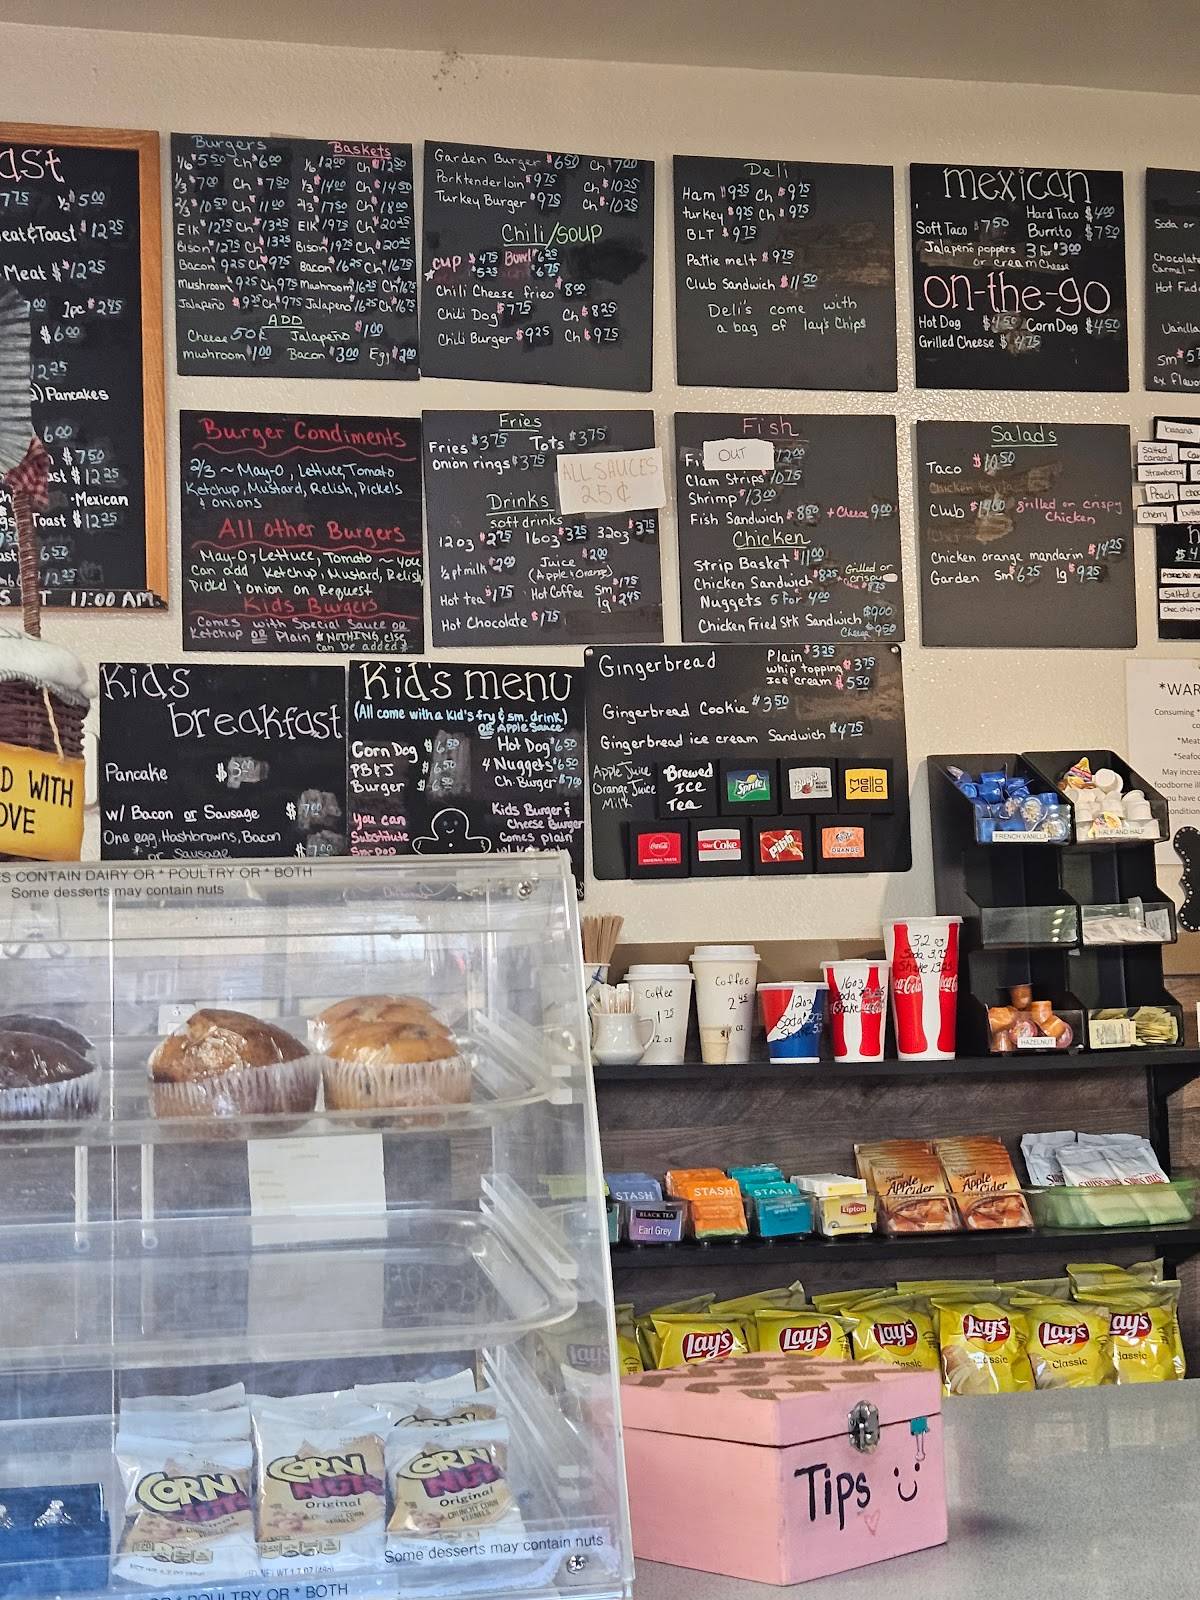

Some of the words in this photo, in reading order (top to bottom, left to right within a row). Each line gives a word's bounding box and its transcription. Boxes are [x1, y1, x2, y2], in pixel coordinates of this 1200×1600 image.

[192, 135, 267, 156] Burgers
[328, 141, 391, 157] Baskets
[435, 149, 487, 164] Garden
[494, 153, 541, 171] Burger
[744, 163, 788, 178] Deli
[435, 190, 480, 206] Turkey
[484, 193, 527, 214] Burger
[682, 187, 715, 202] Ham
[1027, 206, 1053, 219] Hard
[1056, 207, 1079, 219] Taco
[916, 220, 942, 235] Soft
[945, 224, 968, 235] Taco
[1028, 224, 1072, 239] Burrito
[1155, 220, 1178, 228] Soda
[687, 229, 714, 240] BLT
[177, 241, 210, 253] Bison
[296, 240, 328, 252] Bison
[4, 265, 47, 281] Meat
[924, 271, 1110, 316] on-the-go
[438, 308, 465, 320] Chili
[473, 308, 498, 328] Dog
[919, 316, 938, 328] Hot
[941, 317, 961, 329] Dog
[438, 332, 465, 346] Chili
[471, 333, 513, 348] Burger
[919, 335, 954, 348] Grilled
[957, 335, 994, 349] Cheese
[46, 386, 109, 401] Pancakes
[499, 413, 542, 428] Fries
[743, 417, 798, 437] Fish
[199, 418, 285, 449] Burger
[294, 421, 406, 447] Condiments
[991, 426, 1057, 444] Salads
[429, 442, 468, 455] Fries
[530, 436, 565, 450] Tots
[719, 447, 747, 462] OUT
[473, 456, 511, 475] rings
[561, 465, 593, 481] ALL
[600, 458, 659, 479] SAUCES
[926, 461, 962, 474] Taco
[686, 475, 719, 487] Clam
[726, 473, 764, 486] Strips
[689, 493, 737, 507] Shrimp
[1150, 487, 1175, 499] Peach
[487, 492, 549, 511] Drinks
[690, 513, 718, 526] Fish
[726, 509, 783, 525] Sandwich
[930, 505, 964, 517] Club
[733, 528, 811, 547] Chicken
[931, 552, 976, 563] Chicken
[982, 553, 1023, 566] orange
[1030, 548, 1083, 561] mandarin
[694, 576, 744, 591] Chicken
[750, 574, 813, 588] Sandwich
[930, 571, 979, 585] Garden
[70, 592, 115, 606] 11:00
[550, 586, 584, 599] Coffee
[701, 597, 762, 613] Nuggets
[197, 616, 240, 627] Comes
[253, 619, 287, 629] with
[292, 617, 339, 630] Special
[345, 619, 385, 630] Sauce
[442, 618, 461, 632] Hot
[467, 617, 528, 629] Chocolate
[767, 650, 802, 663] Plain
[599, 652, 716, 681] Gingerbread
[101, 663, 191, 700] Kid's
[359, 663, 452, 700] Kid's
[464, 669, 572, 701] menu
[167, 702, 342, 739] breakfast
[355, 701, 373, 721] (All
[377, 708, 405, 719] come
[409, 709, 431, 720] with
[476, 711, 496, 725] fry
[530, 708, 568, 723] drink)
[603, 703, 690, 725] Gingerbread
[700, 701, 749, 716] Cookie
[498, 737, 521, 752] Hot
[525, 738, 551, 757] Dog
[601, 733, 683, 756] Gingerbread
[690, 734, 708, 744] ice
[716, 735, 758, 745] cream
[768, 728, 825, 743] Sandwich
[352, 741, 390, 758] Corn
[391, 742, 418, 763] Dog
[106, 763, 168, 782] Pancake
[494, 758, 553, 778] Nuggets
[593, 764, 622, 779] Apple
[619, 761, 652, 777] Juice
[663, 763, 714, 783] Brewed
[1162, 768, 1176, 777] May
[28, 770, 73, 807] WITH
[351, 780, 404, 796] Burger
[735, 779, 766, 797] Sprite
[1154, 780, 1193, 789] foodborne
[492, 803, 520, 816] Kids
[524, 802, 562, 817] Burger
[351, 830, 409, 843] Substitute
[713, 840, 737, 850] Coke
[15, 871, 80, 882] CONTAIN
[86, 871, 128, 881] DAIRY
[134, 871, 154, 880] OR
[169, 869, 235, 879] POULTRY
[240, 868, 260, 878] OR
[275, 867, 312, 877] BOTH
[11, 888, 49, 898] Some
[54, 887, 110, 898] desserts
[115, 888, 141, 898] may
[146, 885, 192, 895] contain
[197, 885, 224, 894] nuts
[715, 975, 749, 987] Coffee
[645, 988, 673, 998] Coffee
[887, 1176, 919, 1195] Apple
[906, 1183, 934, 1195] Cider
[962, 1173, 992, 1193] Apple
[979, 1180, 1007, 1193] Cider
[694, 1187, 733, 1196] STASH
[754, 1187, 792, 1196] STASH
[842, 1205, 866, 1213] Lipton
[638, 1225, 652, 1235] Earl
[655, 1226, 672, 1237] Grey
[782, 1323, 828, 1351] Lay's
[878, 1322, 914, 1346] Lay's
[966, 1316, 1007, 1342] Lay's
[1043, 1324, 1089, 1346] Lay's
[685, 1329, 733, 1361] Lay's
[1052, 1358, 1088, 1368] Classic
[267, 1453, 367, 1482] CORN
[396, 1448, 494, 1480] CORN
[135, 1471, 241, 1512] CORN
[440, 1487, 494, 1507] Original
[794, 1463, 871, 1531] Tips
[305, 1499, 361, 1509] Original
[385, 1550, 423, 1563] Some
[429, 1543, 485, 1559] desserts
[490, 1542, 518, 1553] may
[523, 1536, 571, 1550] contain
[576, 1535, 603, 1546] nuts
[306, 1584, 348, 1597] BOTH
